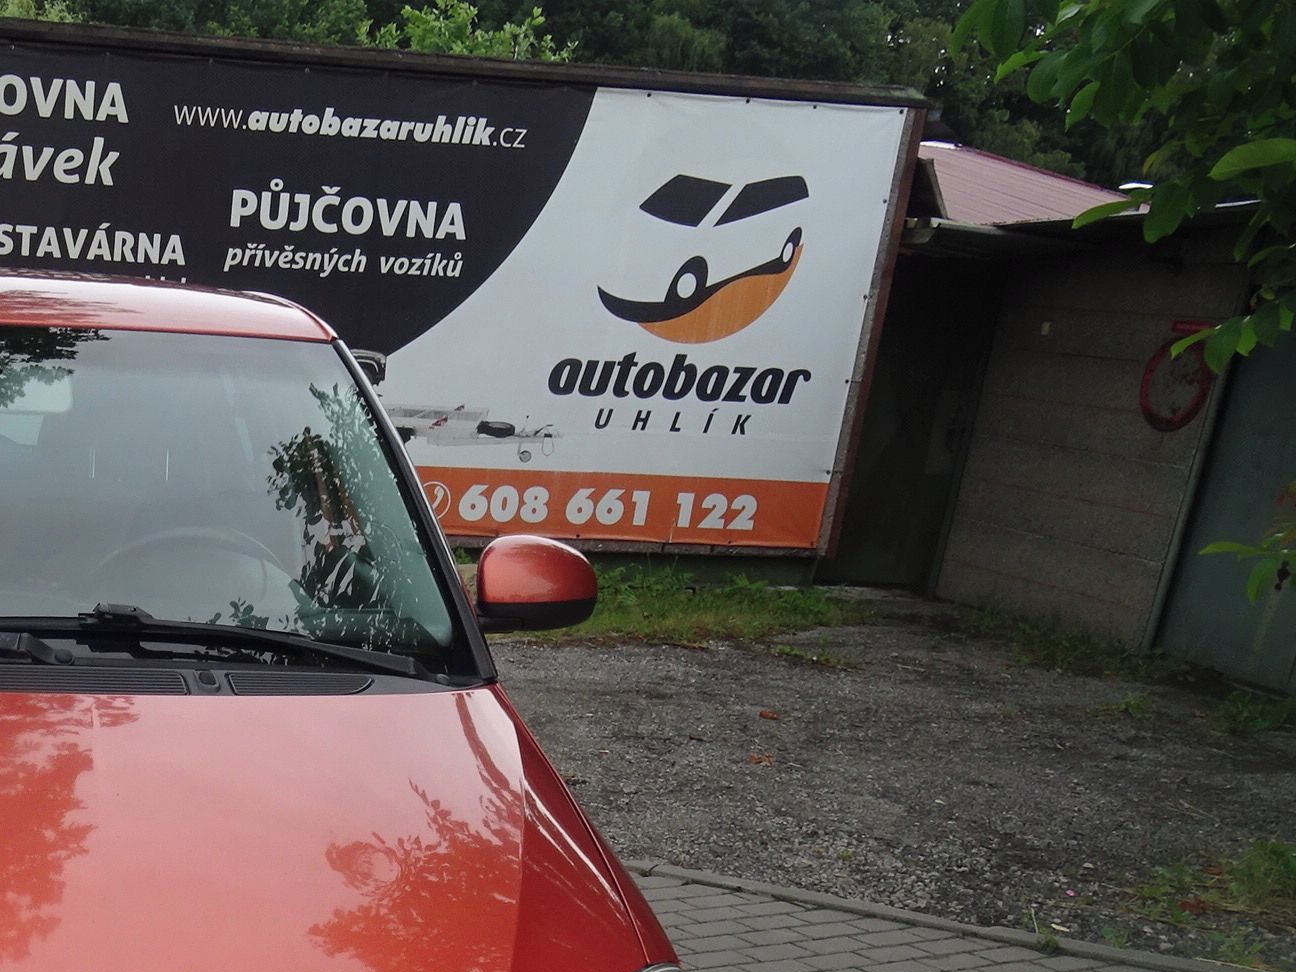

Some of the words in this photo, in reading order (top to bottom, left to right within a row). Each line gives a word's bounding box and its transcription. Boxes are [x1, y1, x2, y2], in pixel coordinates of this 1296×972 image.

[174, 104, 528, 149] www.autobazaruhlik.cz
[230, 178, 466, 241] PŮJČOVNA
[223, 242, 368, 278] přívěsných
[379, 251, 465, 279] vozíků
[547, 351, 812, 405] autobazar
[594, 407, 752, 436] UHLÍK
[458, 484, 550, 523] 608
[565, 487, 652, 526] 661
[676, 492, 758, 530] 122
